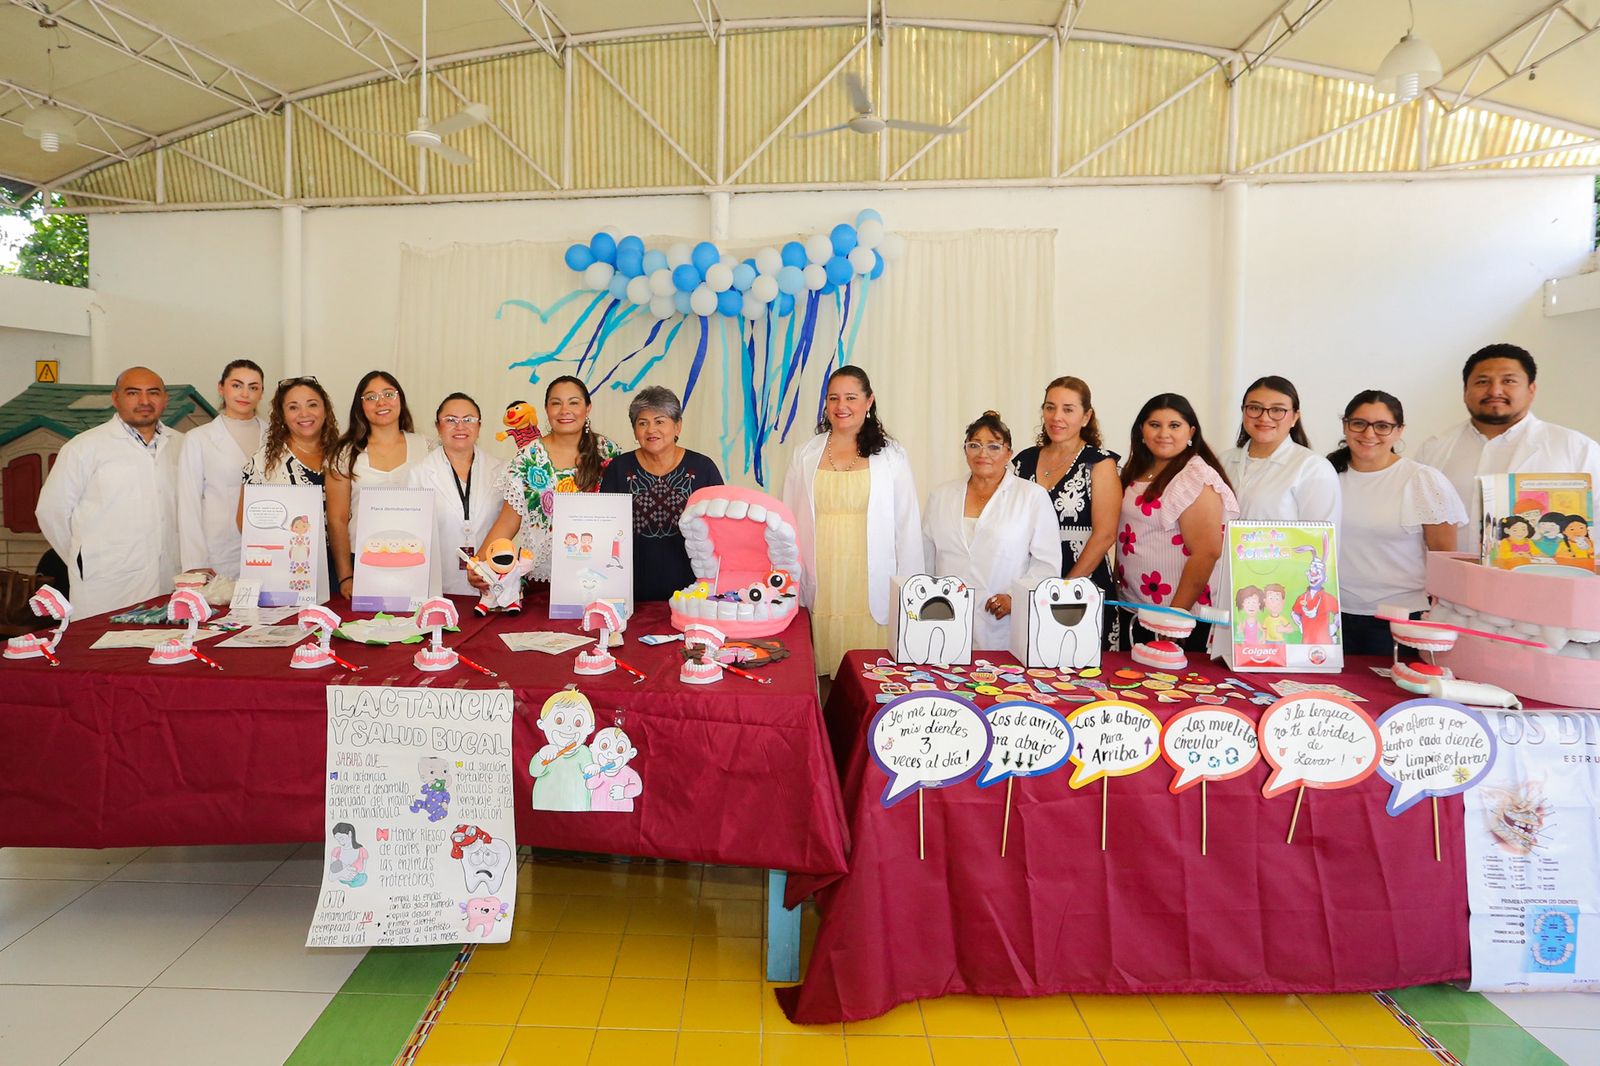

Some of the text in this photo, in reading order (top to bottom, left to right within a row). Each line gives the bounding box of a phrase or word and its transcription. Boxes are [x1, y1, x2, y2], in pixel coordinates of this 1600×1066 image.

[1242, 648, 1277, 656] Colgate
[334, 688, 512, 722] LACTANCIA
[907, 706, 926, 720] me
[900, 720, 968, 738] mis dientes
[990, 711, 1064, 740] Los de arriba
[1072, 710, 1152, 732] Los de abajo
[1389, 720, 1404, 736] Por
[1448, 718, 1468, 731] por
[331, 717, 510, 756] Y SALUD BUCAL
[1182, 716, 1258, 748] Las muelitas
[1274, 727, 1288, 740] no
[1308, 721, 1367, 744] olvides
[920, 737, 932, 754] 3
[1015, 734, 1056, 761] abajo
[1307, 739, 1324, 750] de
[1384, 732, 1484, 752] dentro cada diente
[890, 755, 921, 768] veces
[926, 754, 938, 768] al
[1092, 744, 1139, 765] Arriba
[1294, 751, 1336, 766] Lavar
[1400, 763, 1450, 782] brillantes
[362, 911, 374, 921] NO
